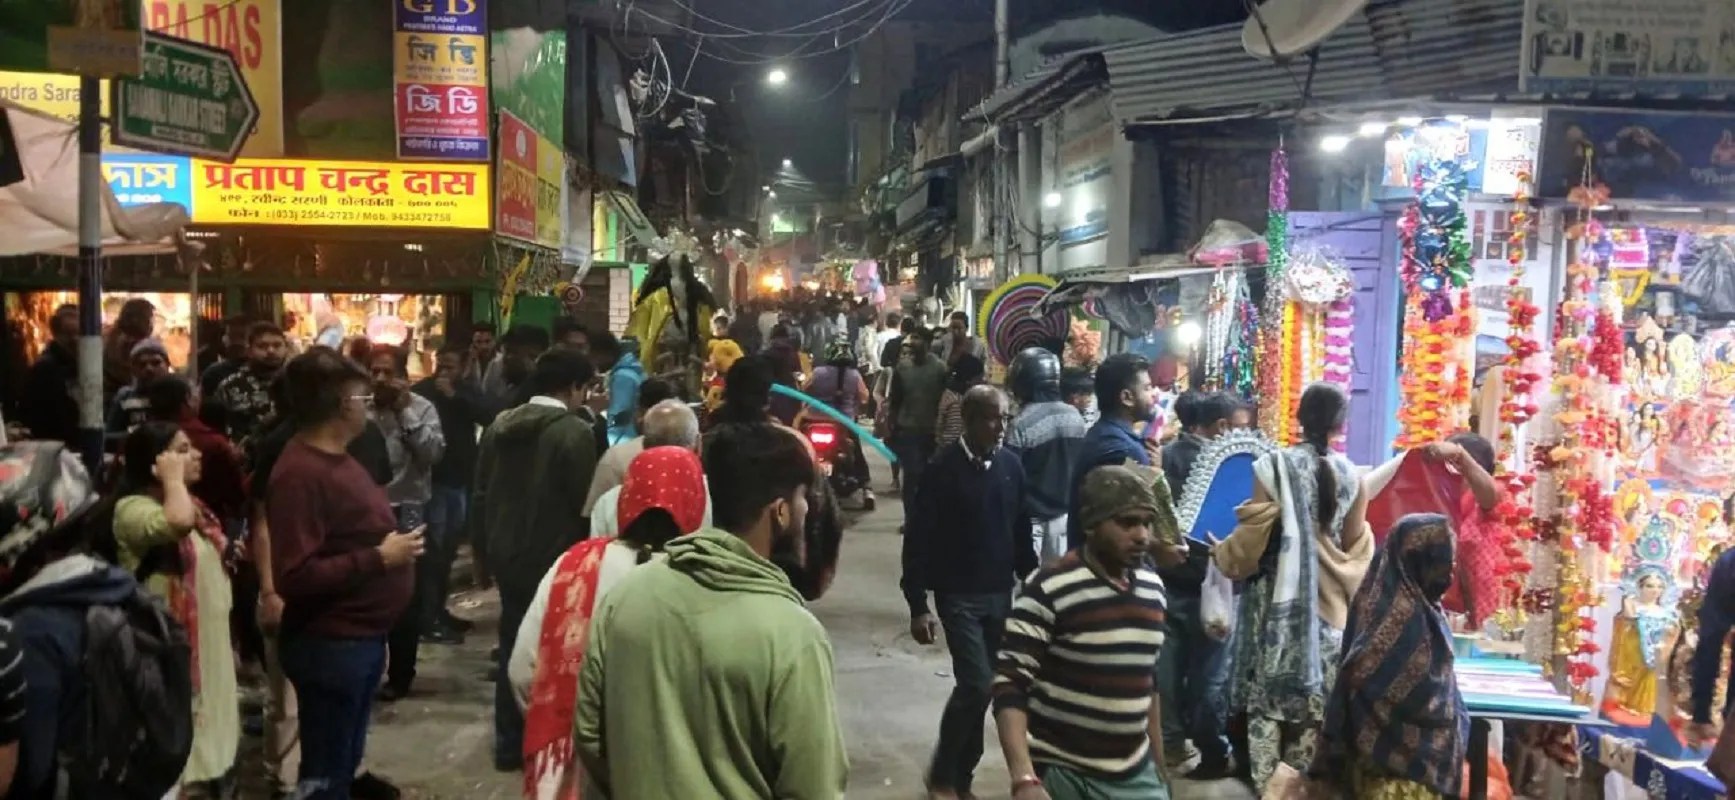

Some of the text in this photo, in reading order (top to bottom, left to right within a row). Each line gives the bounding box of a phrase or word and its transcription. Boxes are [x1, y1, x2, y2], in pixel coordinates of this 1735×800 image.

[203, 2, 263, 70] DAS
[406, 85, 478, 114] জি ডি
[101, 162, 178, 189] দাস
[202, 164, 305, 191] प्रताप
[318, 168, 391, 196] चन्द्र
[402, 170, 477, 197] दास
